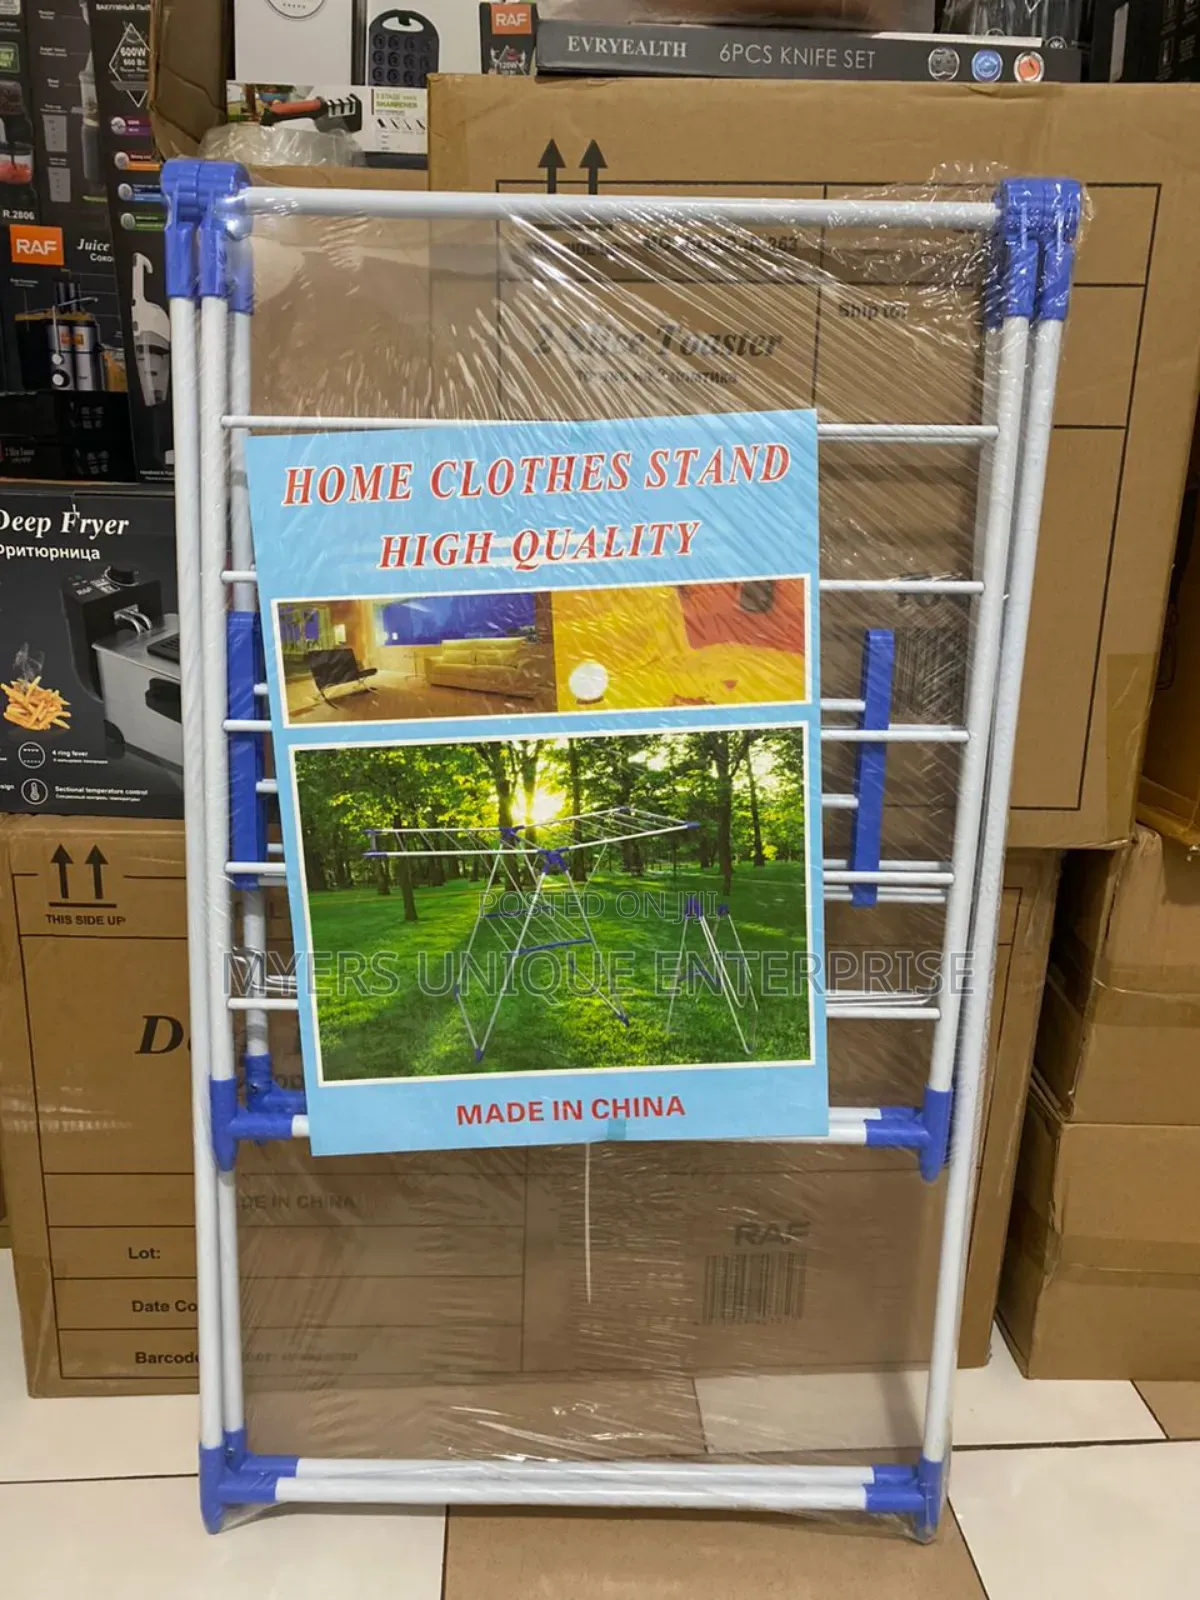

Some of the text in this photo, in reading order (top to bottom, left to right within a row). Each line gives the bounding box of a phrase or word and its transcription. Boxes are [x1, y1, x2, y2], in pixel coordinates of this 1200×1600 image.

[495, 13, 528, 27] RAF
[567, 35, 688, 59] EVRYEALTH
[719, 43, 876, 71] 6PCS KNIFE SET
[3, 209, 35, 220] R.2806
[16, 239, 57, 255] RAF
[77, 239, 111, 252] Juice
[282, 442, 792, 508] HOME CLOTHES STAND
[0, 508, 130, 541] Deep Fryer
[377, 520, 704, 573] HIGH QUALITY
[86, 787, 124, 796] temperature
[44, 913, 126, 927] THIS SIDE UP
[456, 1095, 686, 1126] MADE IN CHINA
[734, 1221, 812, 1246] RAF
[128, 1246, 161, 1260] Lot:
[132, 1299, 170, 1313] Date
